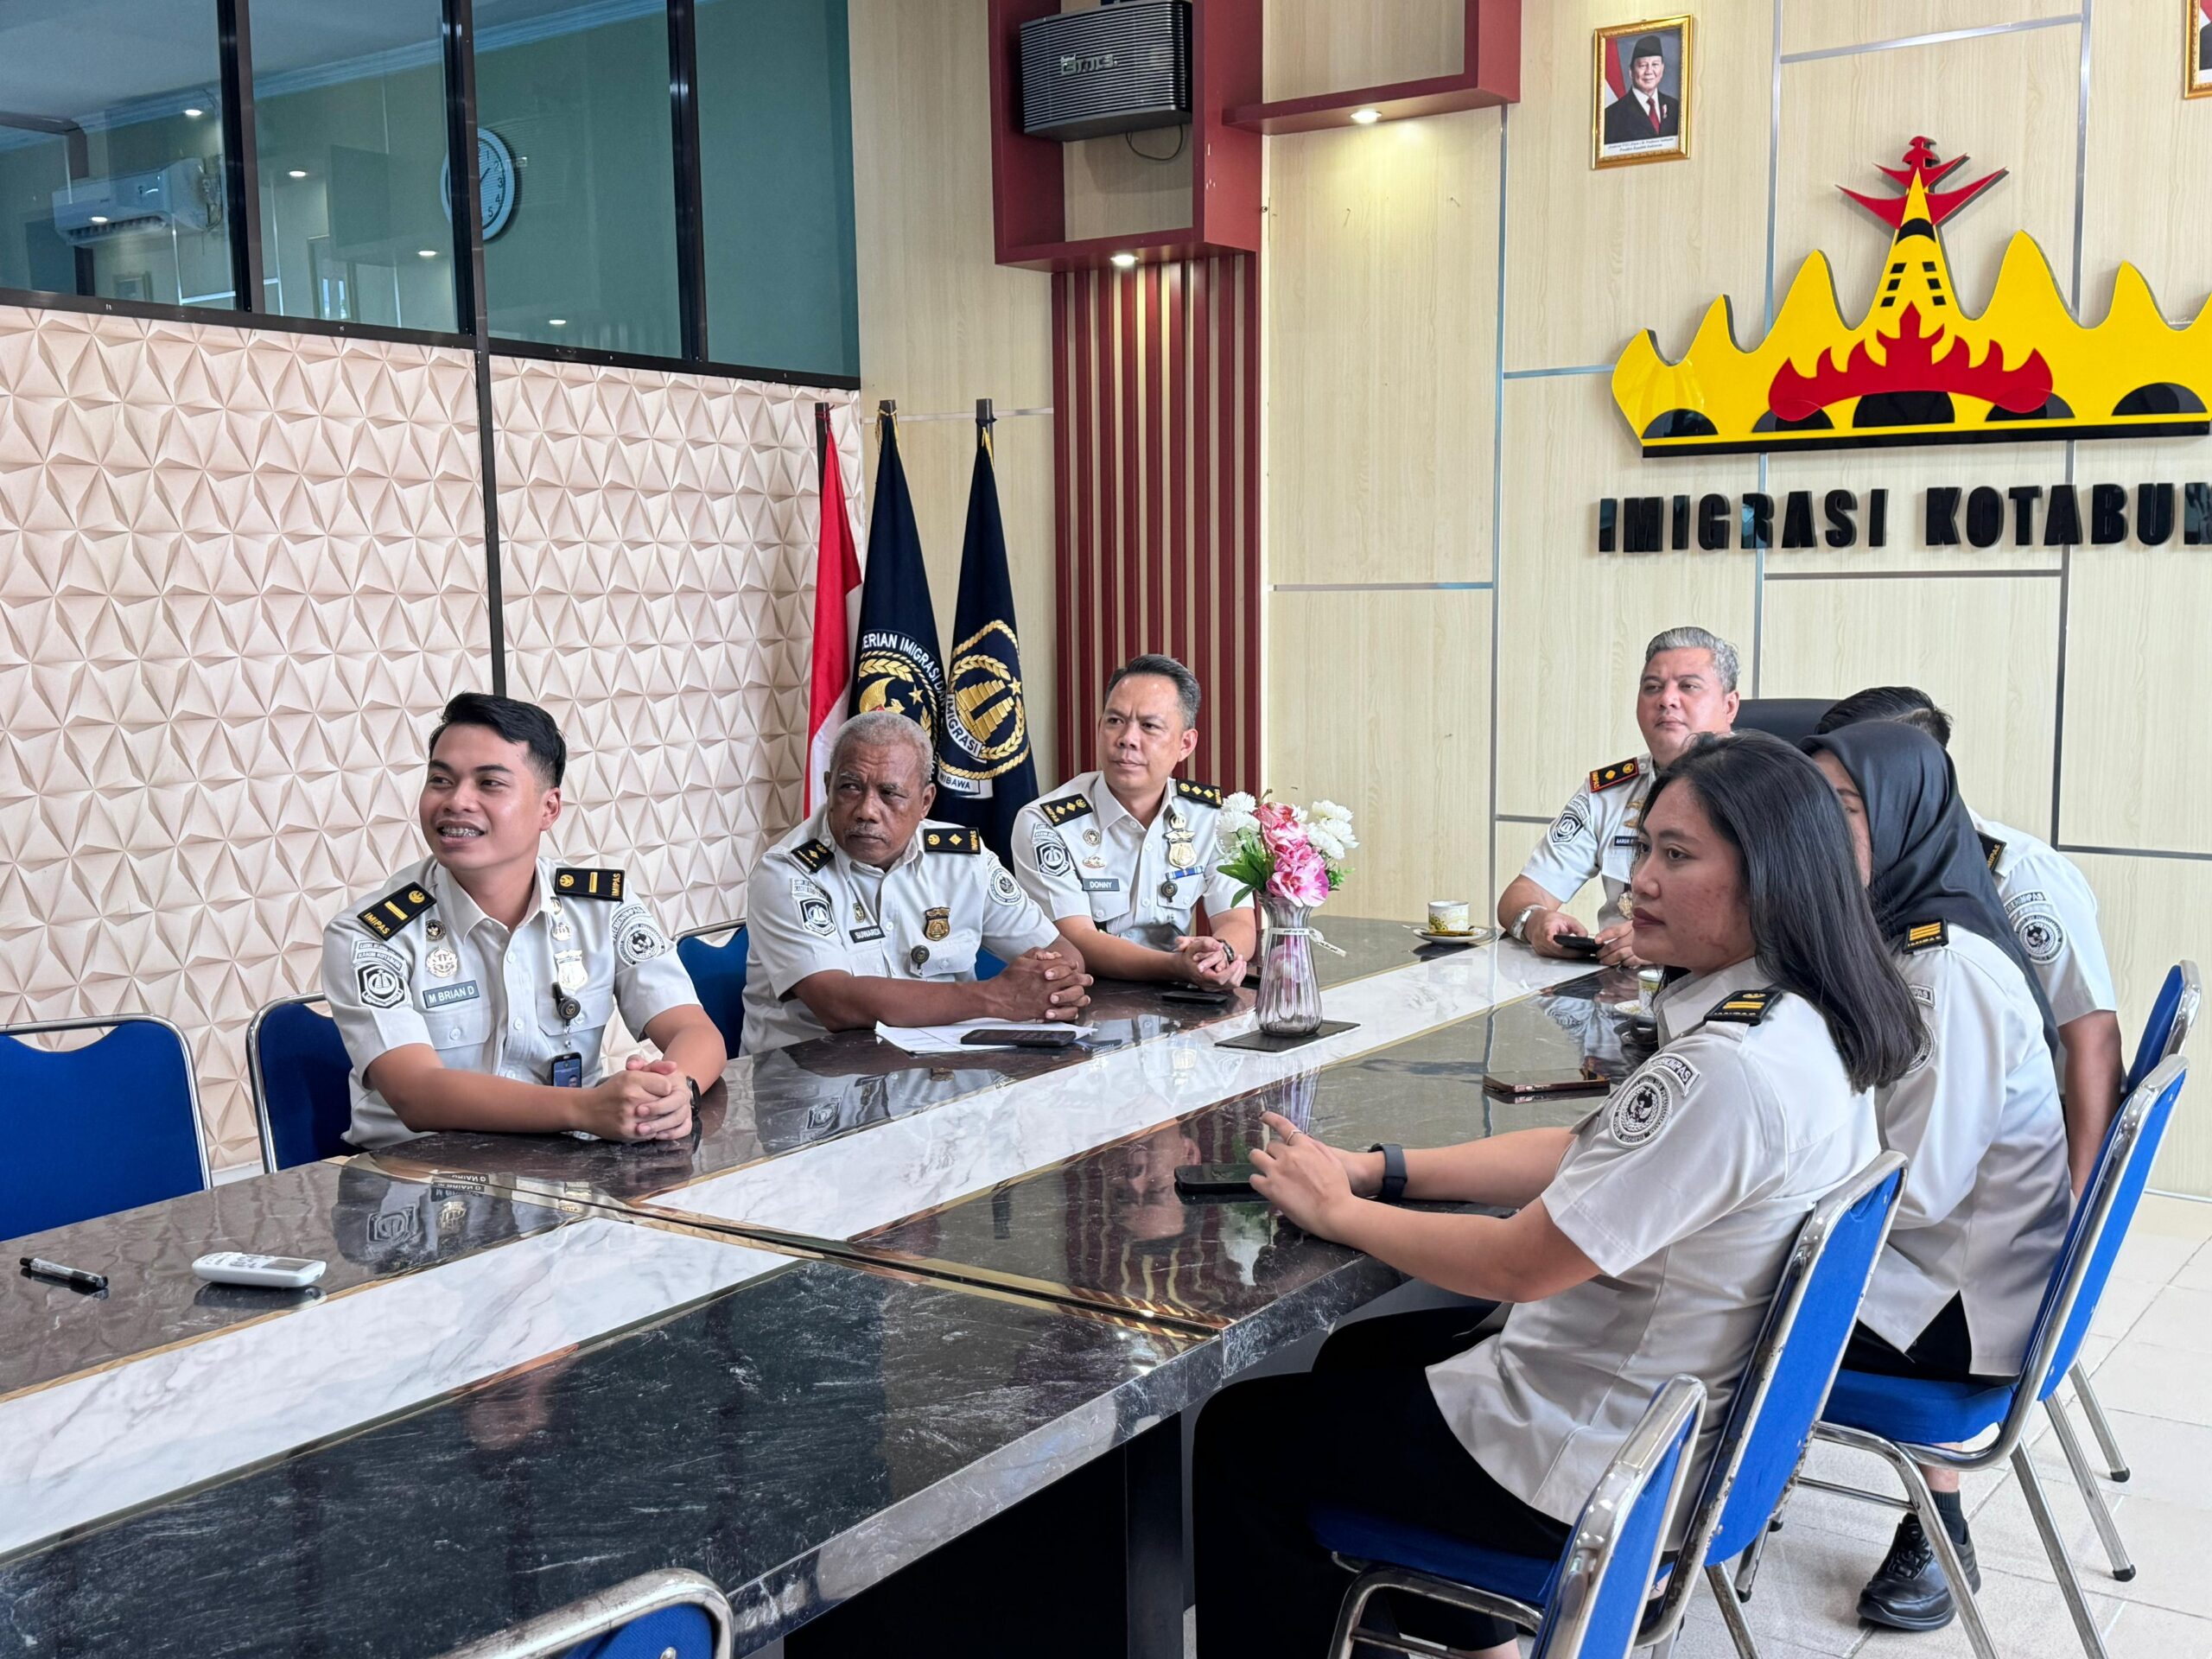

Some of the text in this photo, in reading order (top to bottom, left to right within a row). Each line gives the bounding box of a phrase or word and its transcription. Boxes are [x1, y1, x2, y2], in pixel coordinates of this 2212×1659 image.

[1599, 488, 1888, 553] IMIGRASI
[899, 637, 940, 682] IMIGRASI
[947, 697, 978, 753] IMIGRASI
[1044, 804, 1060, 823] IMIPAS
[611, 873, 621, 897] IMIPAS
[1090, 880, 1113, 889] DONNY
[364, 912, 391, 935] IMIPAS
[429, 986, 474, 1003] M BRIAN D
